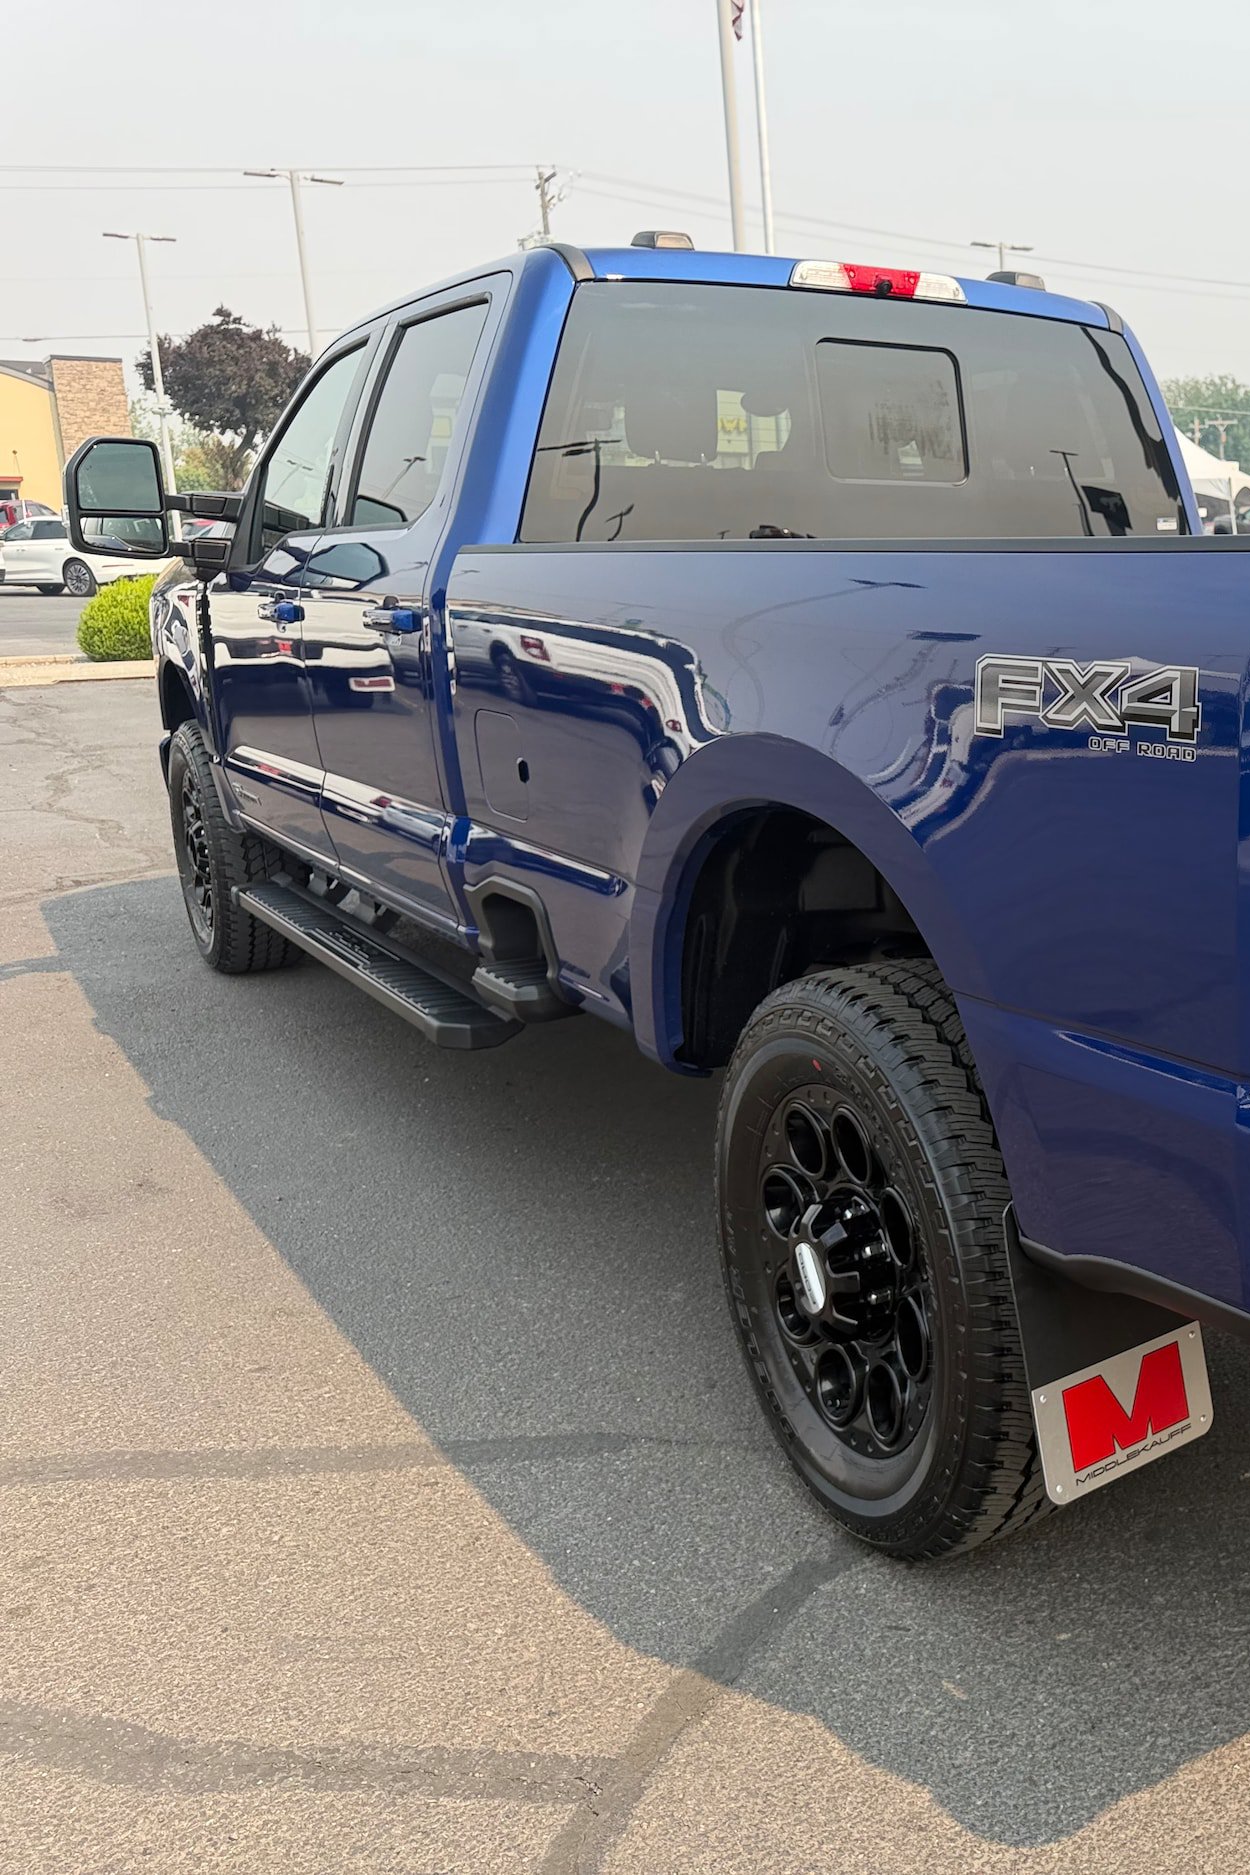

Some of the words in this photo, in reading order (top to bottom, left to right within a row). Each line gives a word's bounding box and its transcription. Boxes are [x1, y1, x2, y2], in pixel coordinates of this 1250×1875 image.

[974, 653, 1202, 744] FX4
[1089, 736, 1131, 753] OFF
[1136, 741, 1197, 762] ROAD
[1062, 1341, 1189, 1473] M
[1075, 1422, 1192, 1487] MIDDLEKAUFF
